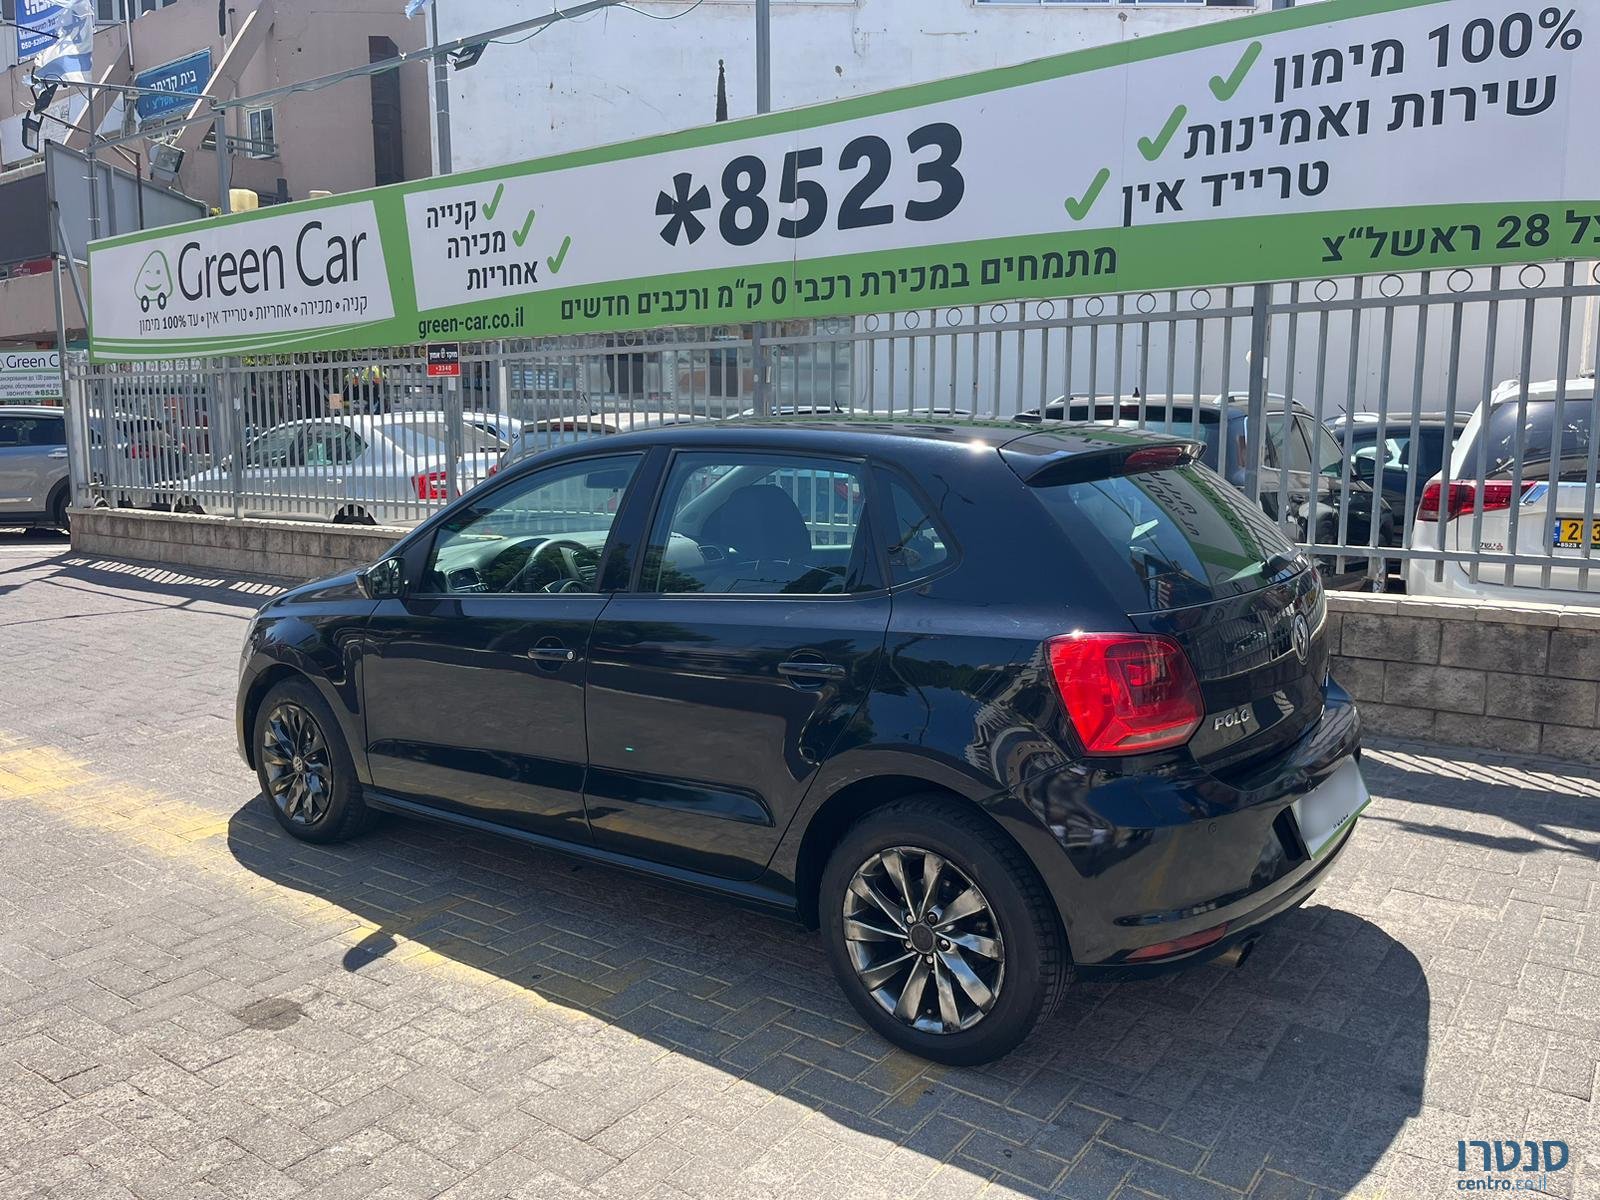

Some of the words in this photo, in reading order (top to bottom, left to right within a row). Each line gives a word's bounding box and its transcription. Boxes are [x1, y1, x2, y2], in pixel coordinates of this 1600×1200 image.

[1429, 8, 1582, 67] 100%
[180, 70, 196, 86] בית
[1275, 40, 1403, 103] מימון
[1388, 76, 1556, 131] שירות
[1184, 100, 1369, 158] ואמינות
[1202, 161, 1328, 206] טרייד
[427, 201, 476, 229] קנייה
[1123, 179, 1185, 227] אין
[448, 230, 505, 259] מכירה
[1496, 213, 1550, 248] 28
[178, 242, 285, 301] Green
[296, 221, 367, 287] Car
[981, 247, 1117, 286] מתמחים
[467, 261, 538, 290] אחריות
[795, 275, 850, 302] רכבי
[860, 263, 970, 296] במכירת
[638, 288, 709, 314] ורכבים
[772, 277, 787, 305] 0
[222, 308, 247, 323] טרייד
[256, 303, 292, 321] אחריות
[301, 300, 333, 316] מכירה
[343, 296, 368, 315] קניה
[562, 294, 630, 320] חדשים
[139, 318, 160, 336] מימון
[162, 315, 187, 329] 100%
[187, 314, 199, 327] עד
[206, 311, 219, 329] אין
[418, 306, 524, 339] green-car.co.il
[7, 354, 46, 368] Green
[1213, 709, 1251, 731] POLO
